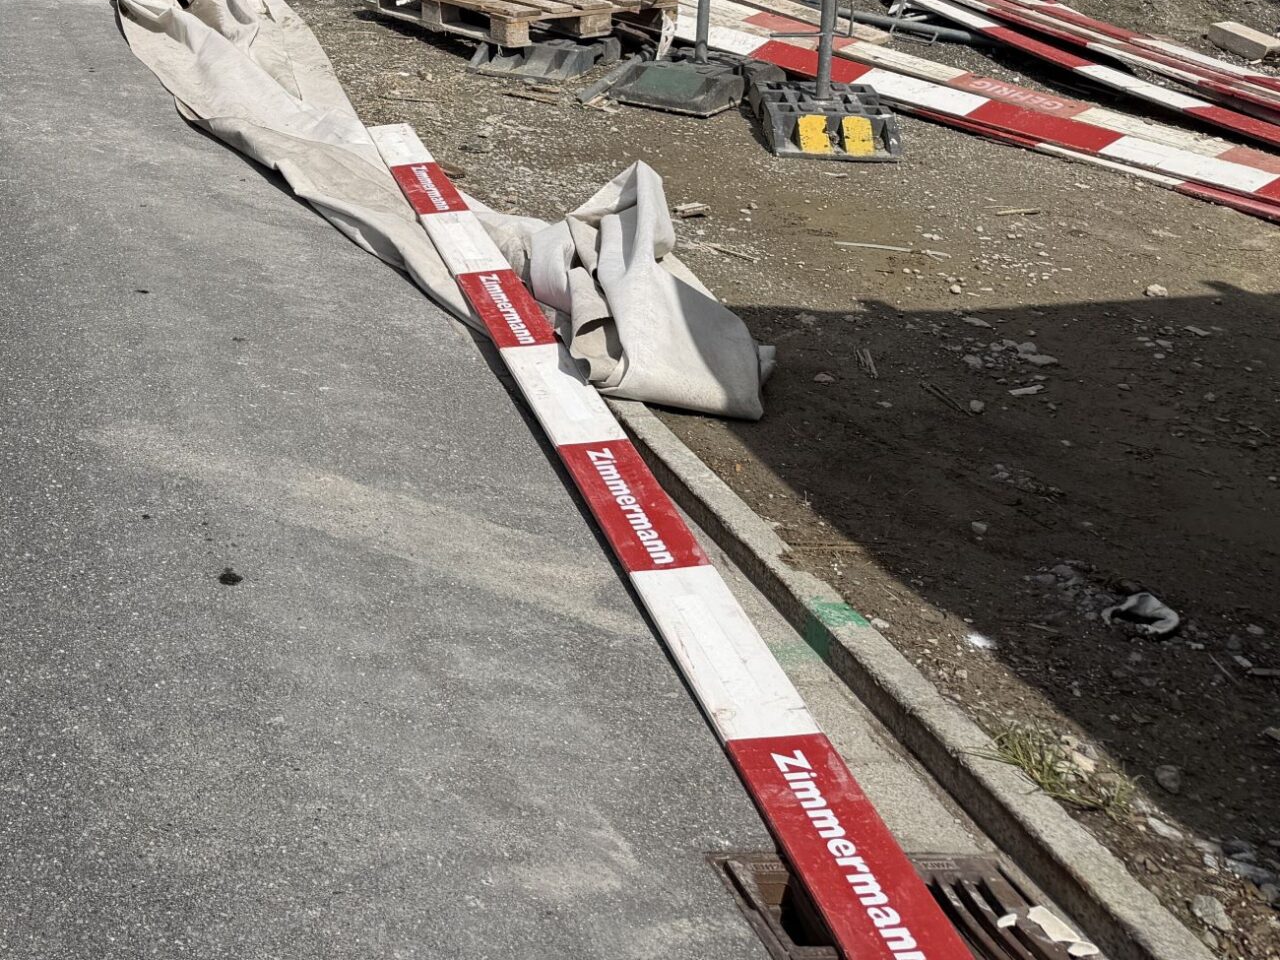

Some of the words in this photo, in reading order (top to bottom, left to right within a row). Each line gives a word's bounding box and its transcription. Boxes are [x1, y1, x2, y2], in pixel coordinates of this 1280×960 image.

[968, 80, 1065, 111] GEHRIG
[410, 164, 450, 211] Zimmermann
[478, 273, 536, 345] Zimmermann
[586, 447, 674, 565] Zimmermann
